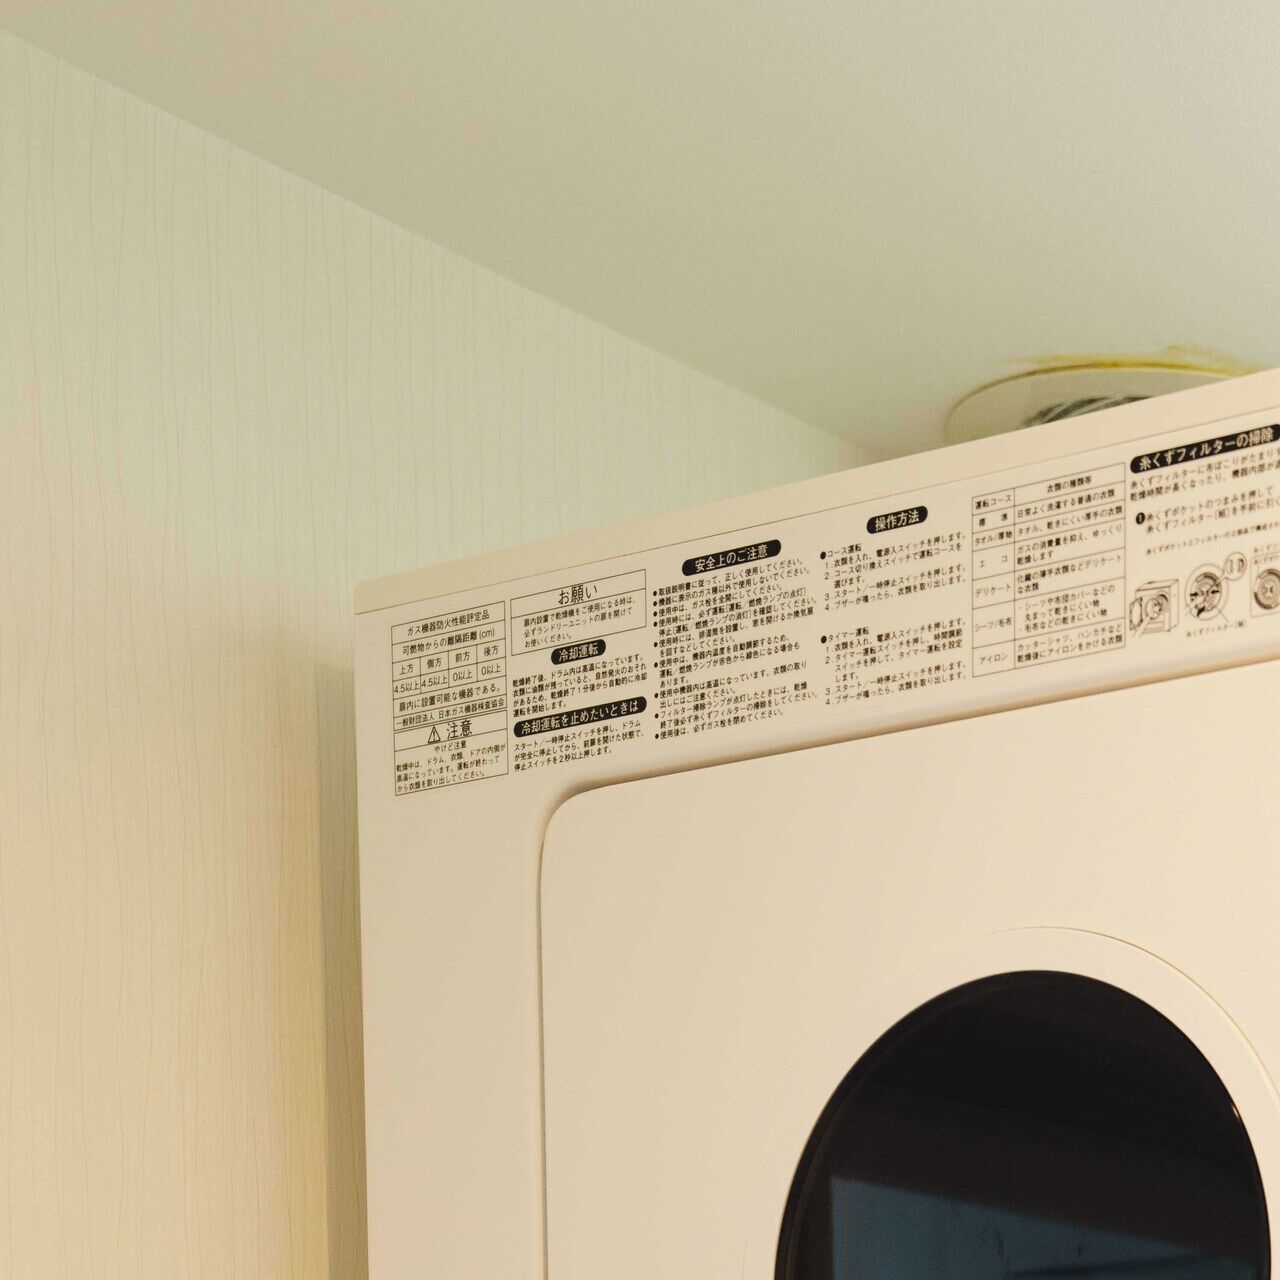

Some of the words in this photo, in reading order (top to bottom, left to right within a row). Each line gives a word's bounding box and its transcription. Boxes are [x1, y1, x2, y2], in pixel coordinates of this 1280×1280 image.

[1139, 426, 1275, 471] 糸くずフィルターの掃除
[875, 509, 920, 532] 操作方法
[694, 543, 768, 573] 安全上のご注意
[558, 582, 597, 605] お願い
[408, 609, 489, 636] ガス機器防火性能評定品
[455, 651, 470, 662] 前方
[484, 645, 498, 656] 後方
[558, 641, 598, 663] 冷却運転
[399, 663, 413, 675] 上方
[426, 656, 442, 669] 側方
[453, 670, 472, 682] 0以上
[481, 663, 501, 676] 0以上
[393, 681, 419, 693] 4.5以上
[421, 675, 447, 687] 4.5以上
[522, 696, 638, 734] 冷却運転を止めたいときは
[446, 719, 472, 739] 注意
[434, 740, 467, 752] やけど注意
